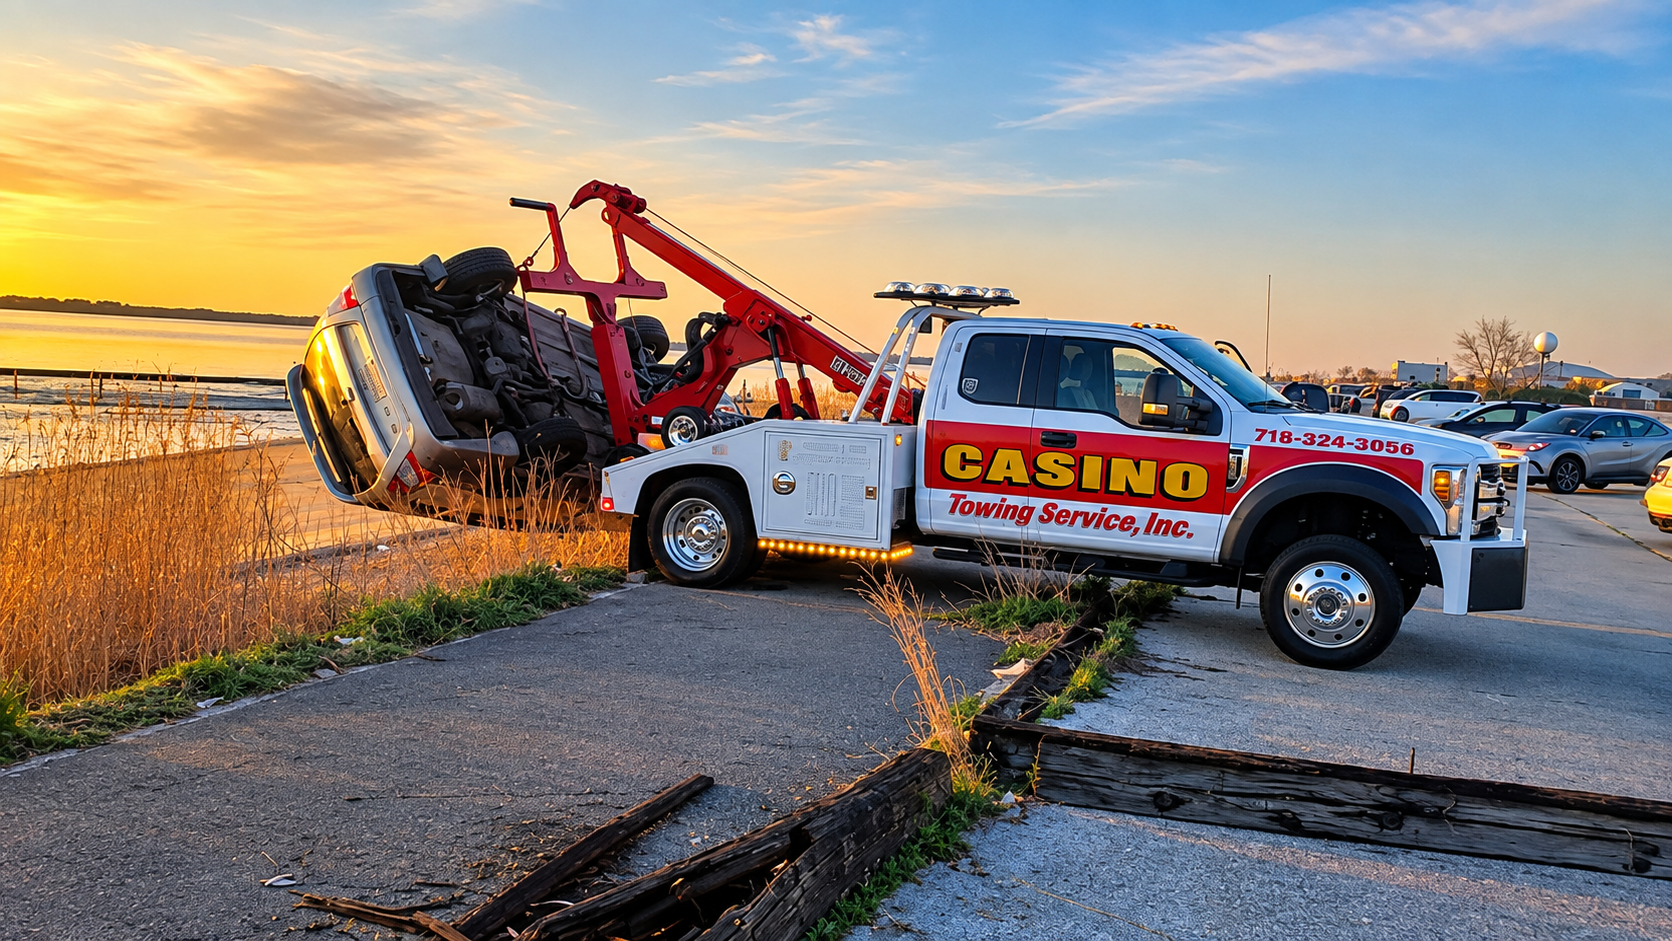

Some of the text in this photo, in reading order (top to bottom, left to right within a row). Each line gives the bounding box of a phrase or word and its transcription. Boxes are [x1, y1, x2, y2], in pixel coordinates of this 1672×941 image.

[1255, 428, 1415, 456] 718-324-3056
[940, 443, 1209, 502] CASINO
[948, 493, 1194, 539] Towing Service, Inc.
